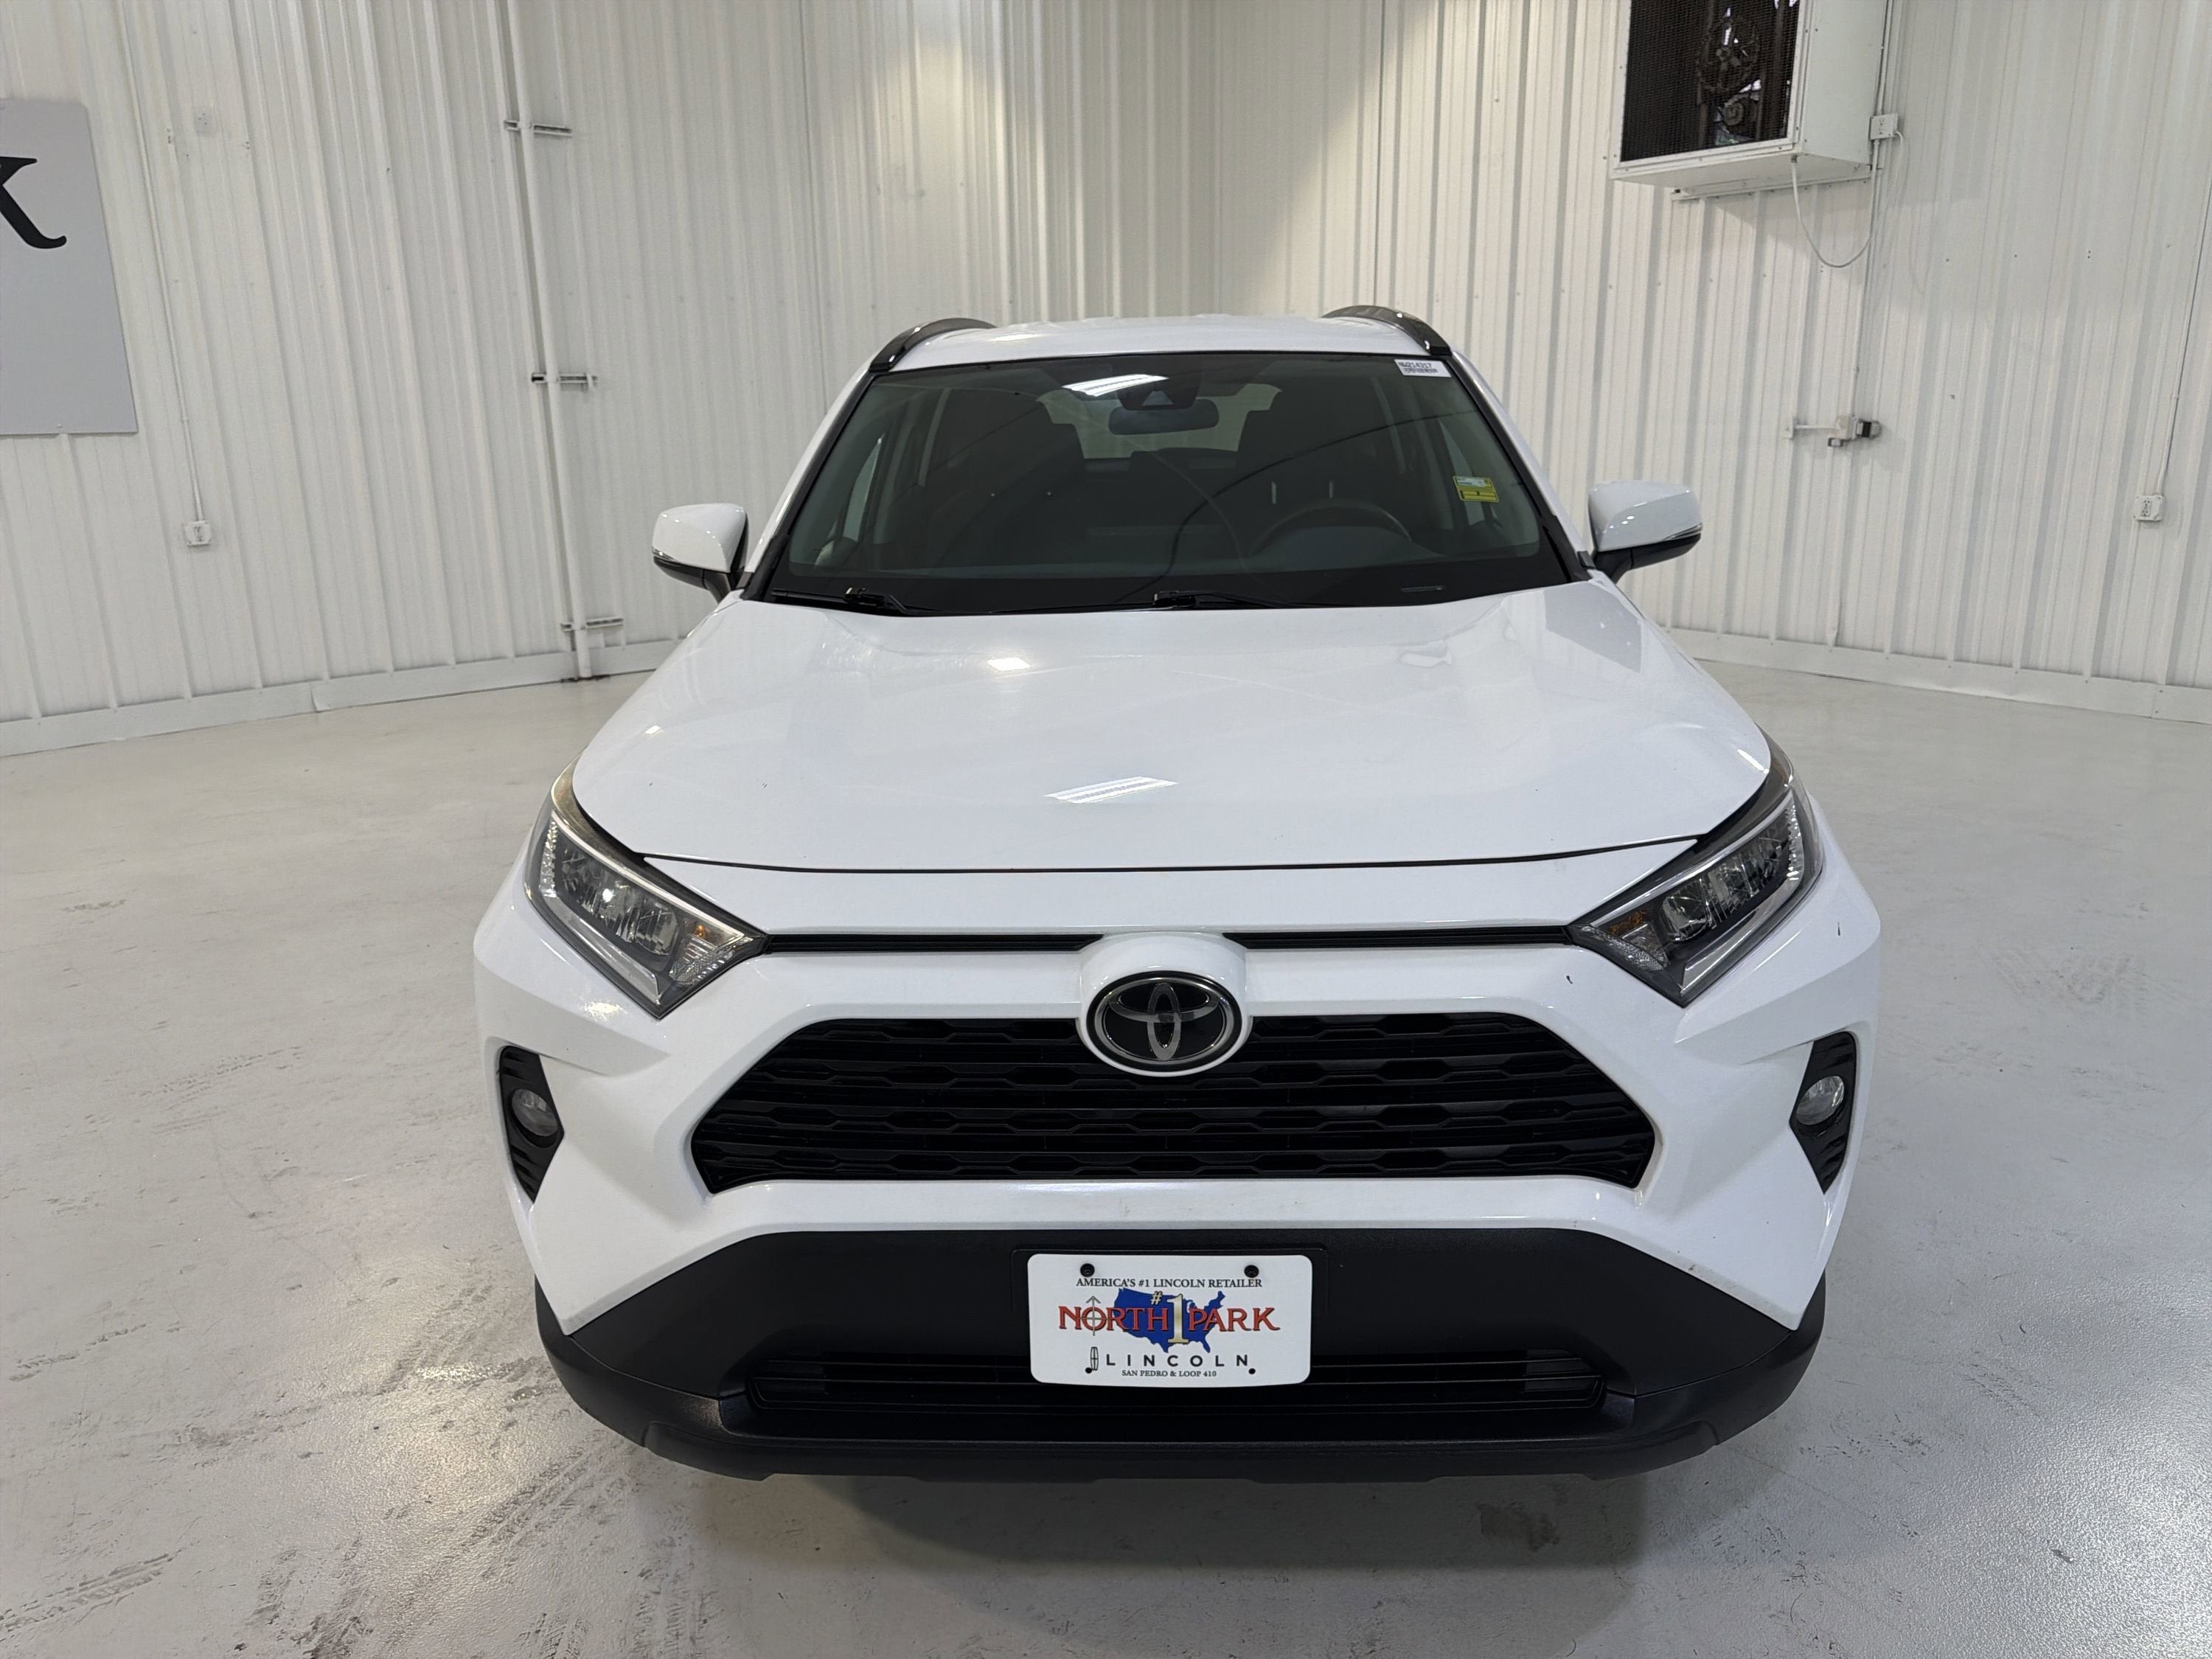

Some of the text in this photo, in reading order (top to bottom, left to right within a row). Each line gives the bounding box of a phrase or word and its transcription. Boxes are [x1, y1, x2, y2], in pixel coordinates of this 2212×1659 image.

[1076, 1278, 1263, 1288] AMERICA'S #1 LINCOLN RETAILER
[1057, 1306, 1281, 1332] NORTH PARK
[1106, 1354, 1248, 1367] LINCOLN
